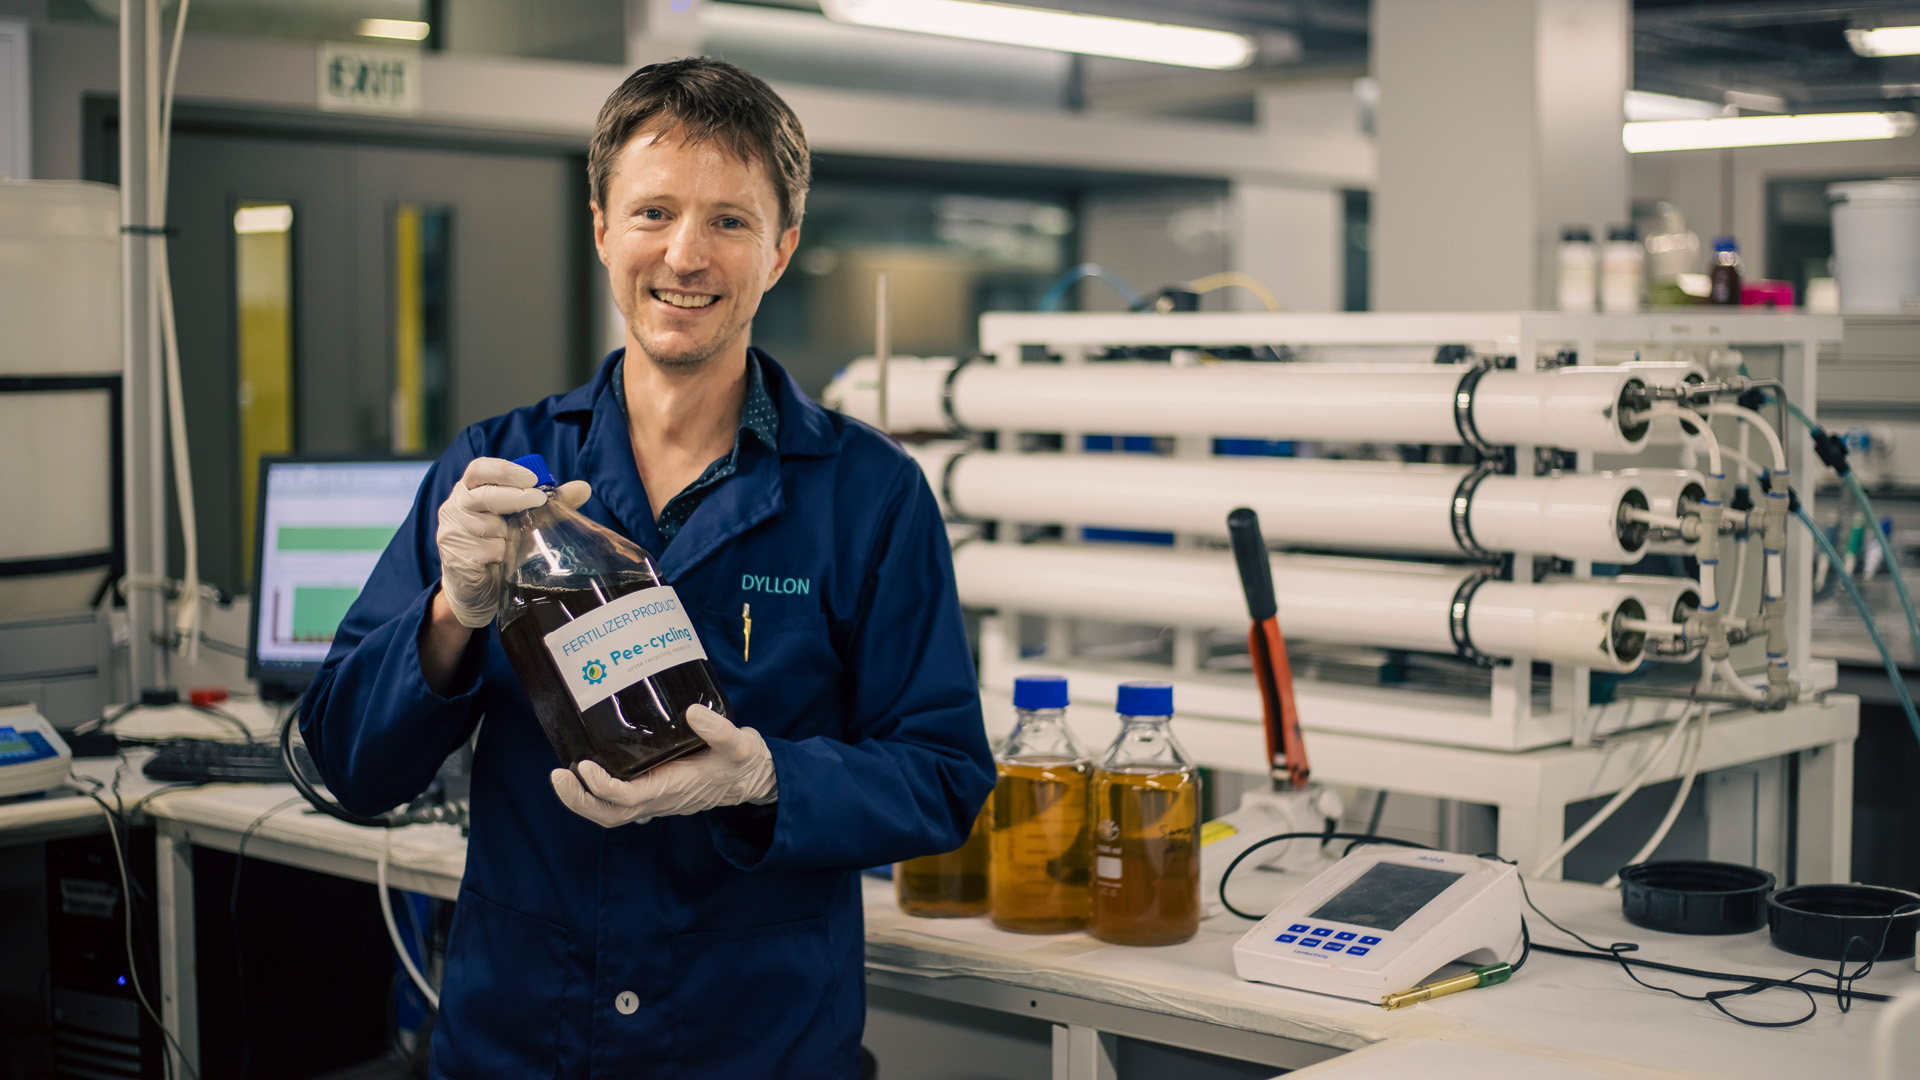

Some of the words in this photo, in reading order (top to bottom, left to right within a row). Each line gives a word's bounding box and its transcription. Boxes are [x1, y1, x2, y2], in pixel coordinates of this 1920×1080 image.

[327, 57, 404, 98] EXIT
[742, 574, 810, 595] DYLLON
[562, 613, 633, 657] FERTILIZER
[632, 599, 678, 621] PRODUCT
[610, 627, 692, 666] Pee-cycling
